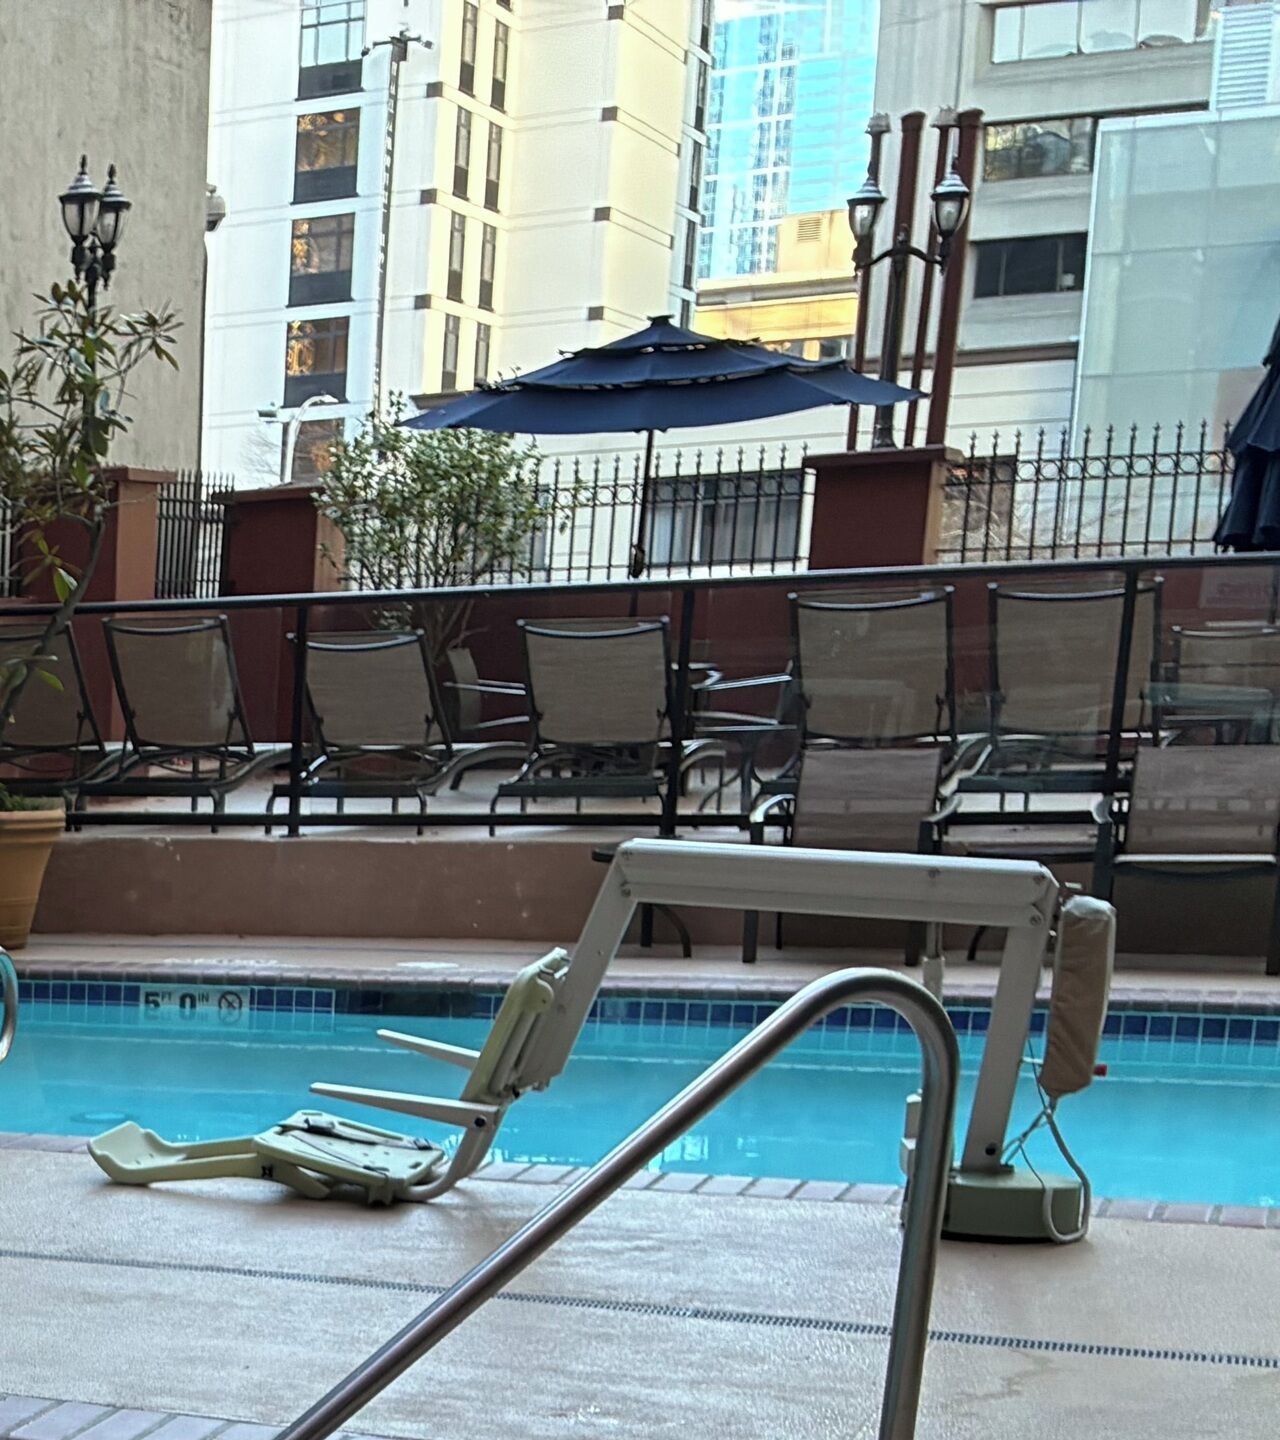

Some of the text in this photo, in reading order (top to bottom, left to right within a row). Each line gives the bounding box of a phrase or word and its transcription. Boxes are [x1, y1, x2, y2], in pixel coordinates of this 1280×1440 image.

[145, 992, 160, 1009] 5
[180, 993, 197, 1009] 0
[198, 991, 210, 1003] IN
